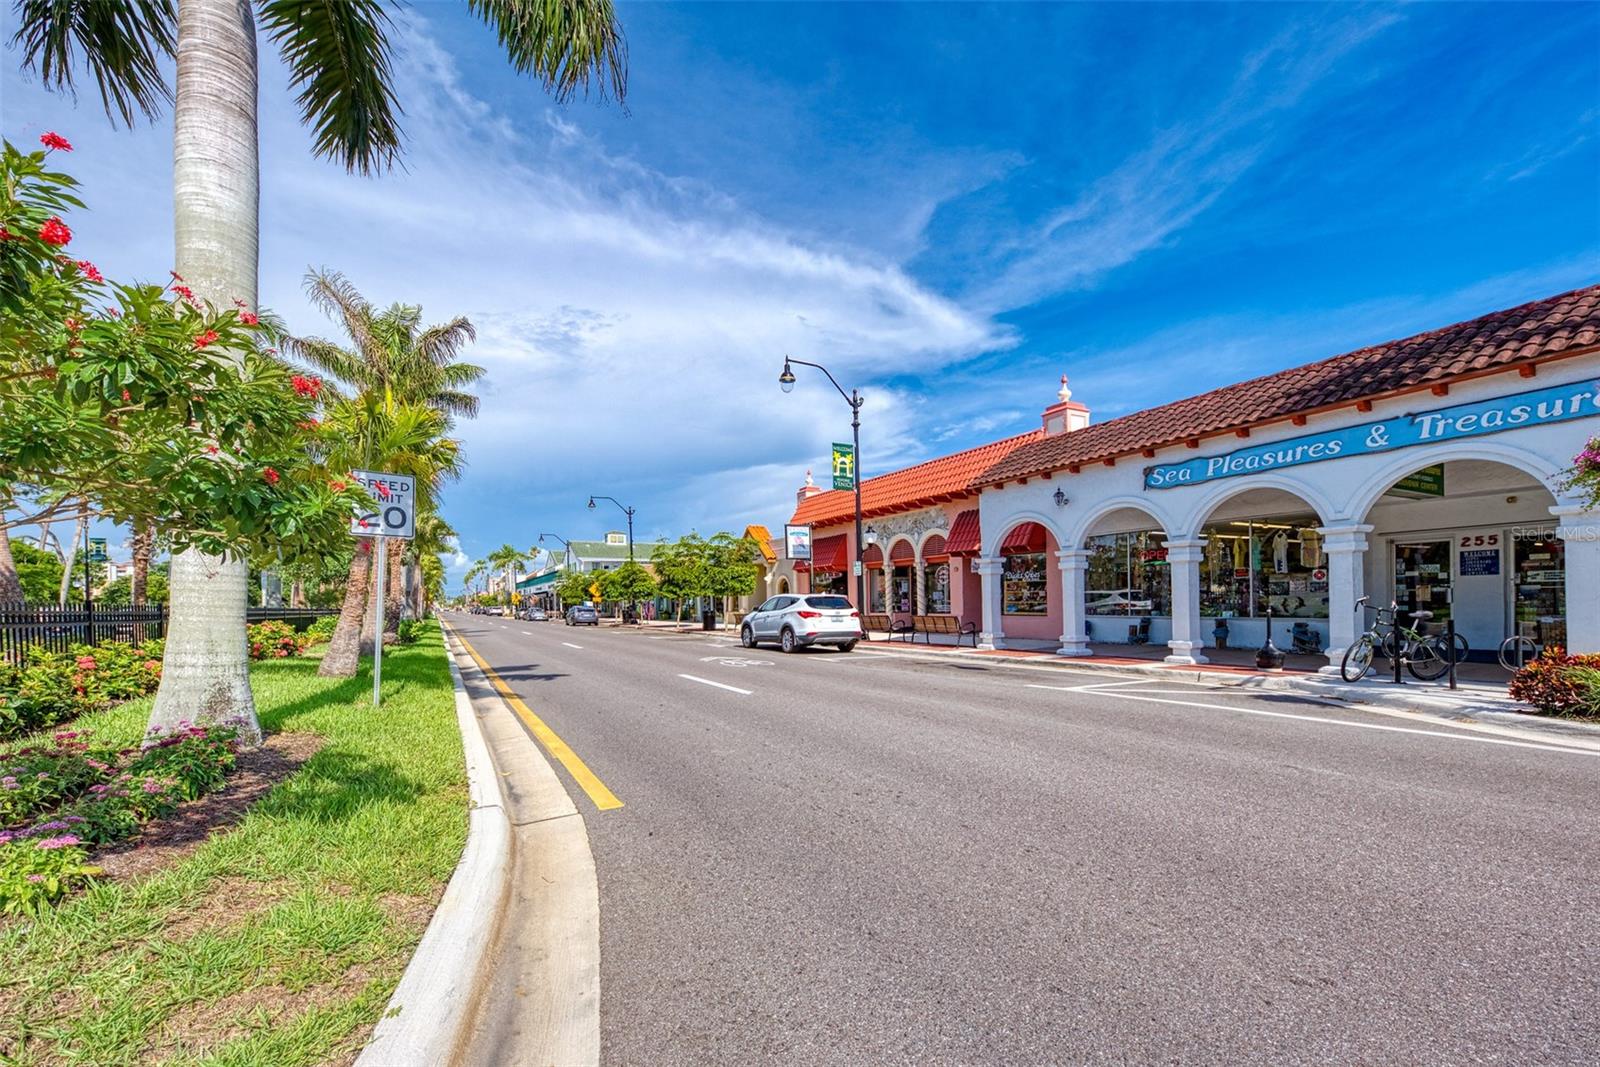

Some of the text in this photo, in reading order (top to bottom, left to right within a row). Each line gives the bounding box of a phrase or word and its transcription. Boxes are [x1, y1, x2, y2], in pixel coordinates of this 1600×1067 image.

[1151, 468, 1191, 485] Sea
[1207, 439, 1343, 477] Pleasures
[1365, 425, 1390, 448] &
[373, 492, 403, 503] IMIT
[1460, 534, 1499, 547] 255
